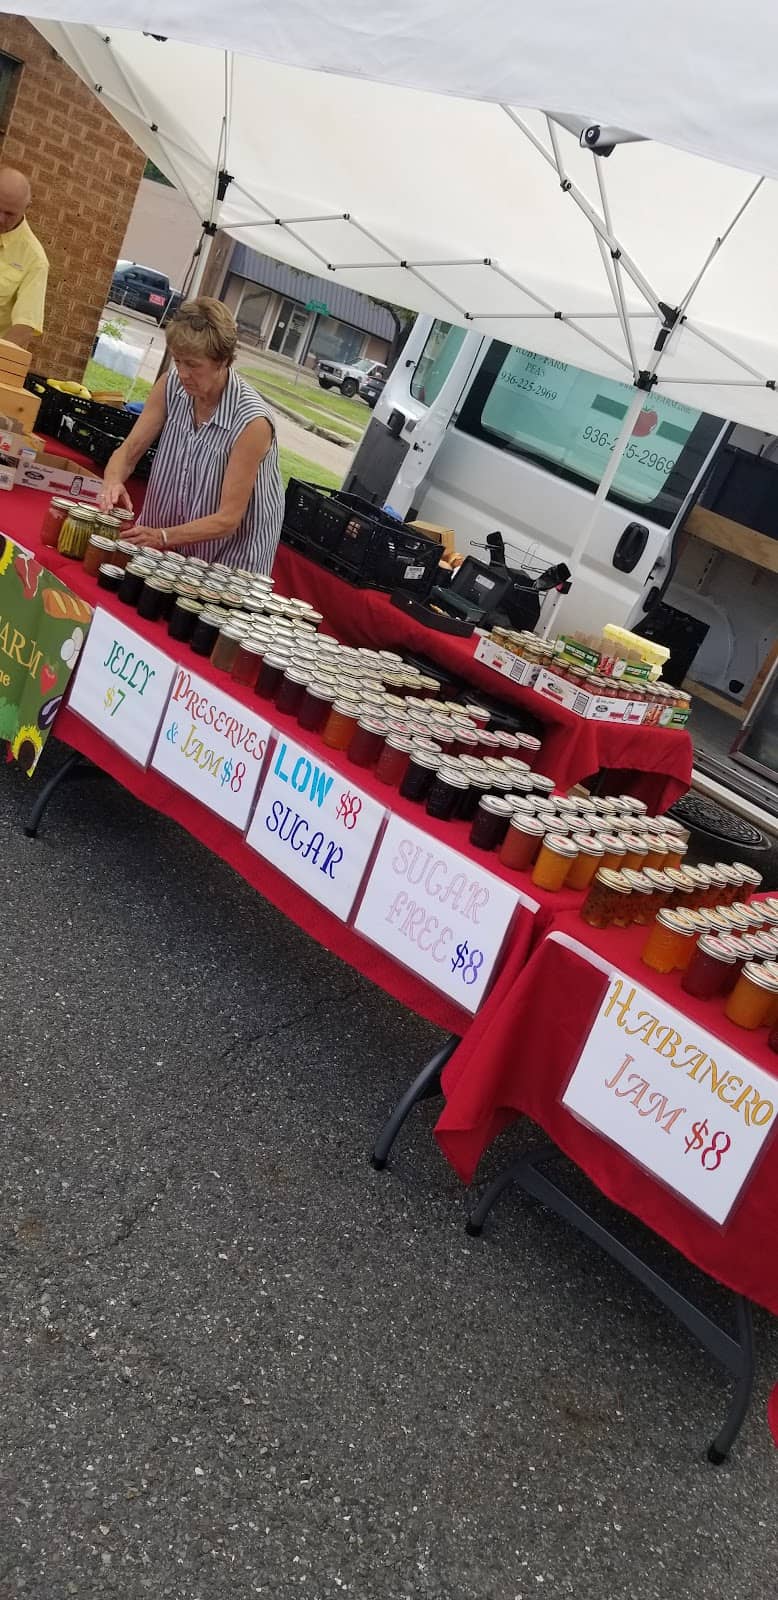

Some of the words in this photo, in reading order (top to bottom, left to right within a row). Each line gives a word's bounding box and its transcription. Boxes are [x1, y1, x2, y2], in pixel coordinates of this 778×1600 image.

[501, 371, 558, 401] 936-225-2969
[583, 425, 675, 475] 936-25-2969
[0, 616, 44, 679] ARM
[104, 640, 155, 696] JELLY
[104, 688, 126, 717] $7
[172, 670, 266, 760] PRESERVES
[166, 722, 178, 744] &
[181, 724, 224, 778] JAM
[220, 758, 246, 792] $8
[274, 743, 334, 808] LOW
[336, 790, 362, 830] $8
[265, 800, 343, 879] SUGAR
[392, 839, 490, 924] SUGAR
[385, 891, 453, 963] FREE
[451, 940, 484, 984] $8
[604, 979, 774, 1127] HABANERO
[604, 1053, 686, 1135] JAM
[684, 1119, 730, 1171] $8
